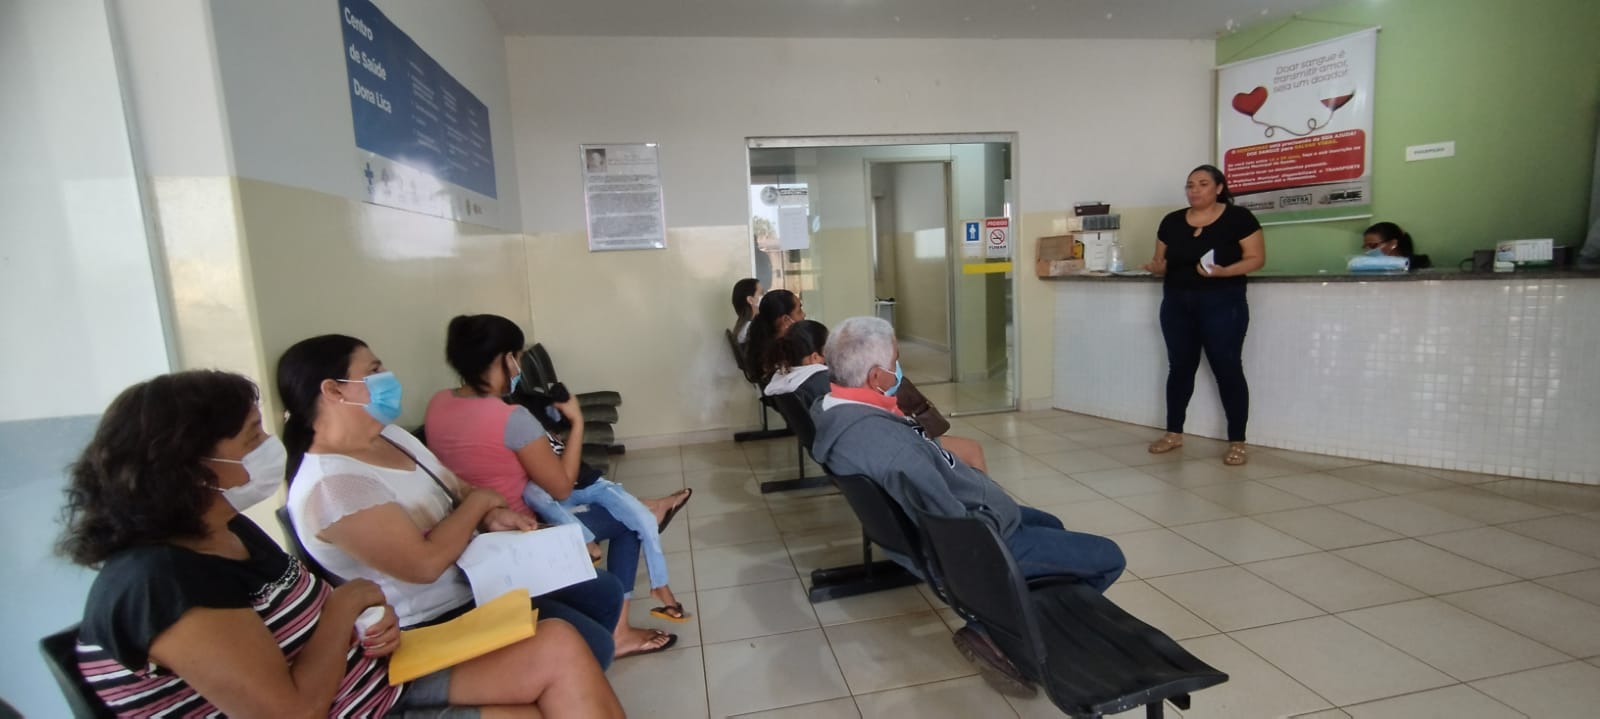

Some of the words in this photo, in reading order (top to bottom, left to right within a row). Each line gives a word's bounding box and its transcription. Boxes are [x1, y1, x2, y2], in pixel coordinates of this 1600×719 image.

[344, 6, 374, 41] Centro
[349, 43, 361, 64] de
[361, 51, 387, 81] Saúde
[1276, 63, 1299, 75] Doar
[1301, 53, 1337, 67] sangue
[353, 77, 376, 105] Dona
[375, 91, 393, 114] Lica
[1293, 79, 1310, 89] um
